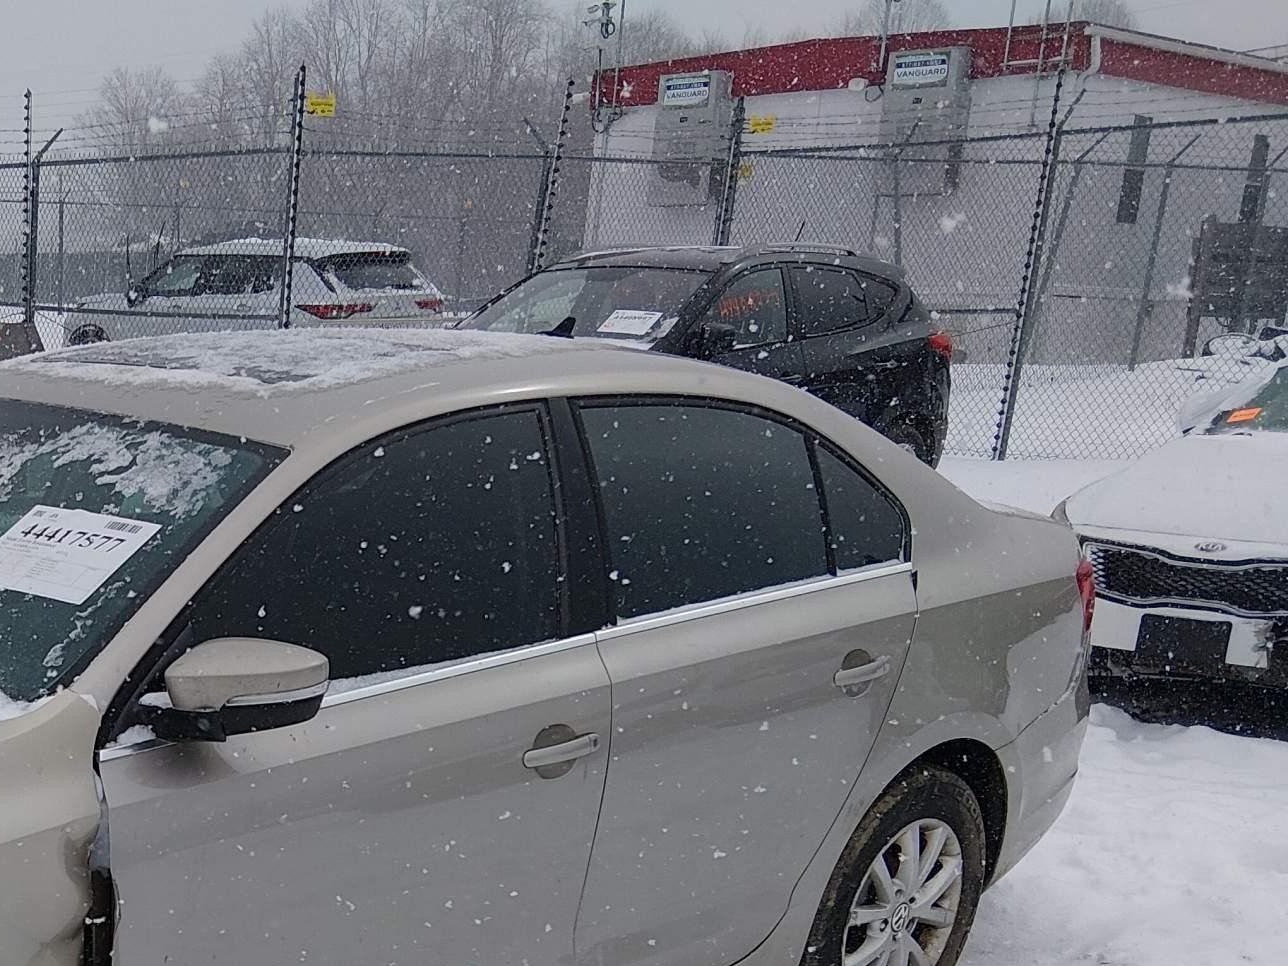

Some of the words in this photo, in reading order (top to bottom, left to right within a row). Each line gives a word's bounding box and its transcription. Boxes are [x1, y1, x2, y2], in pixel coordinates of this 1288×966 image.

[896, 67, 946, 78] VANGUARD
[666, 89, 708, 99] VANGUARD
[20, 523, 127, 553] 44417577
